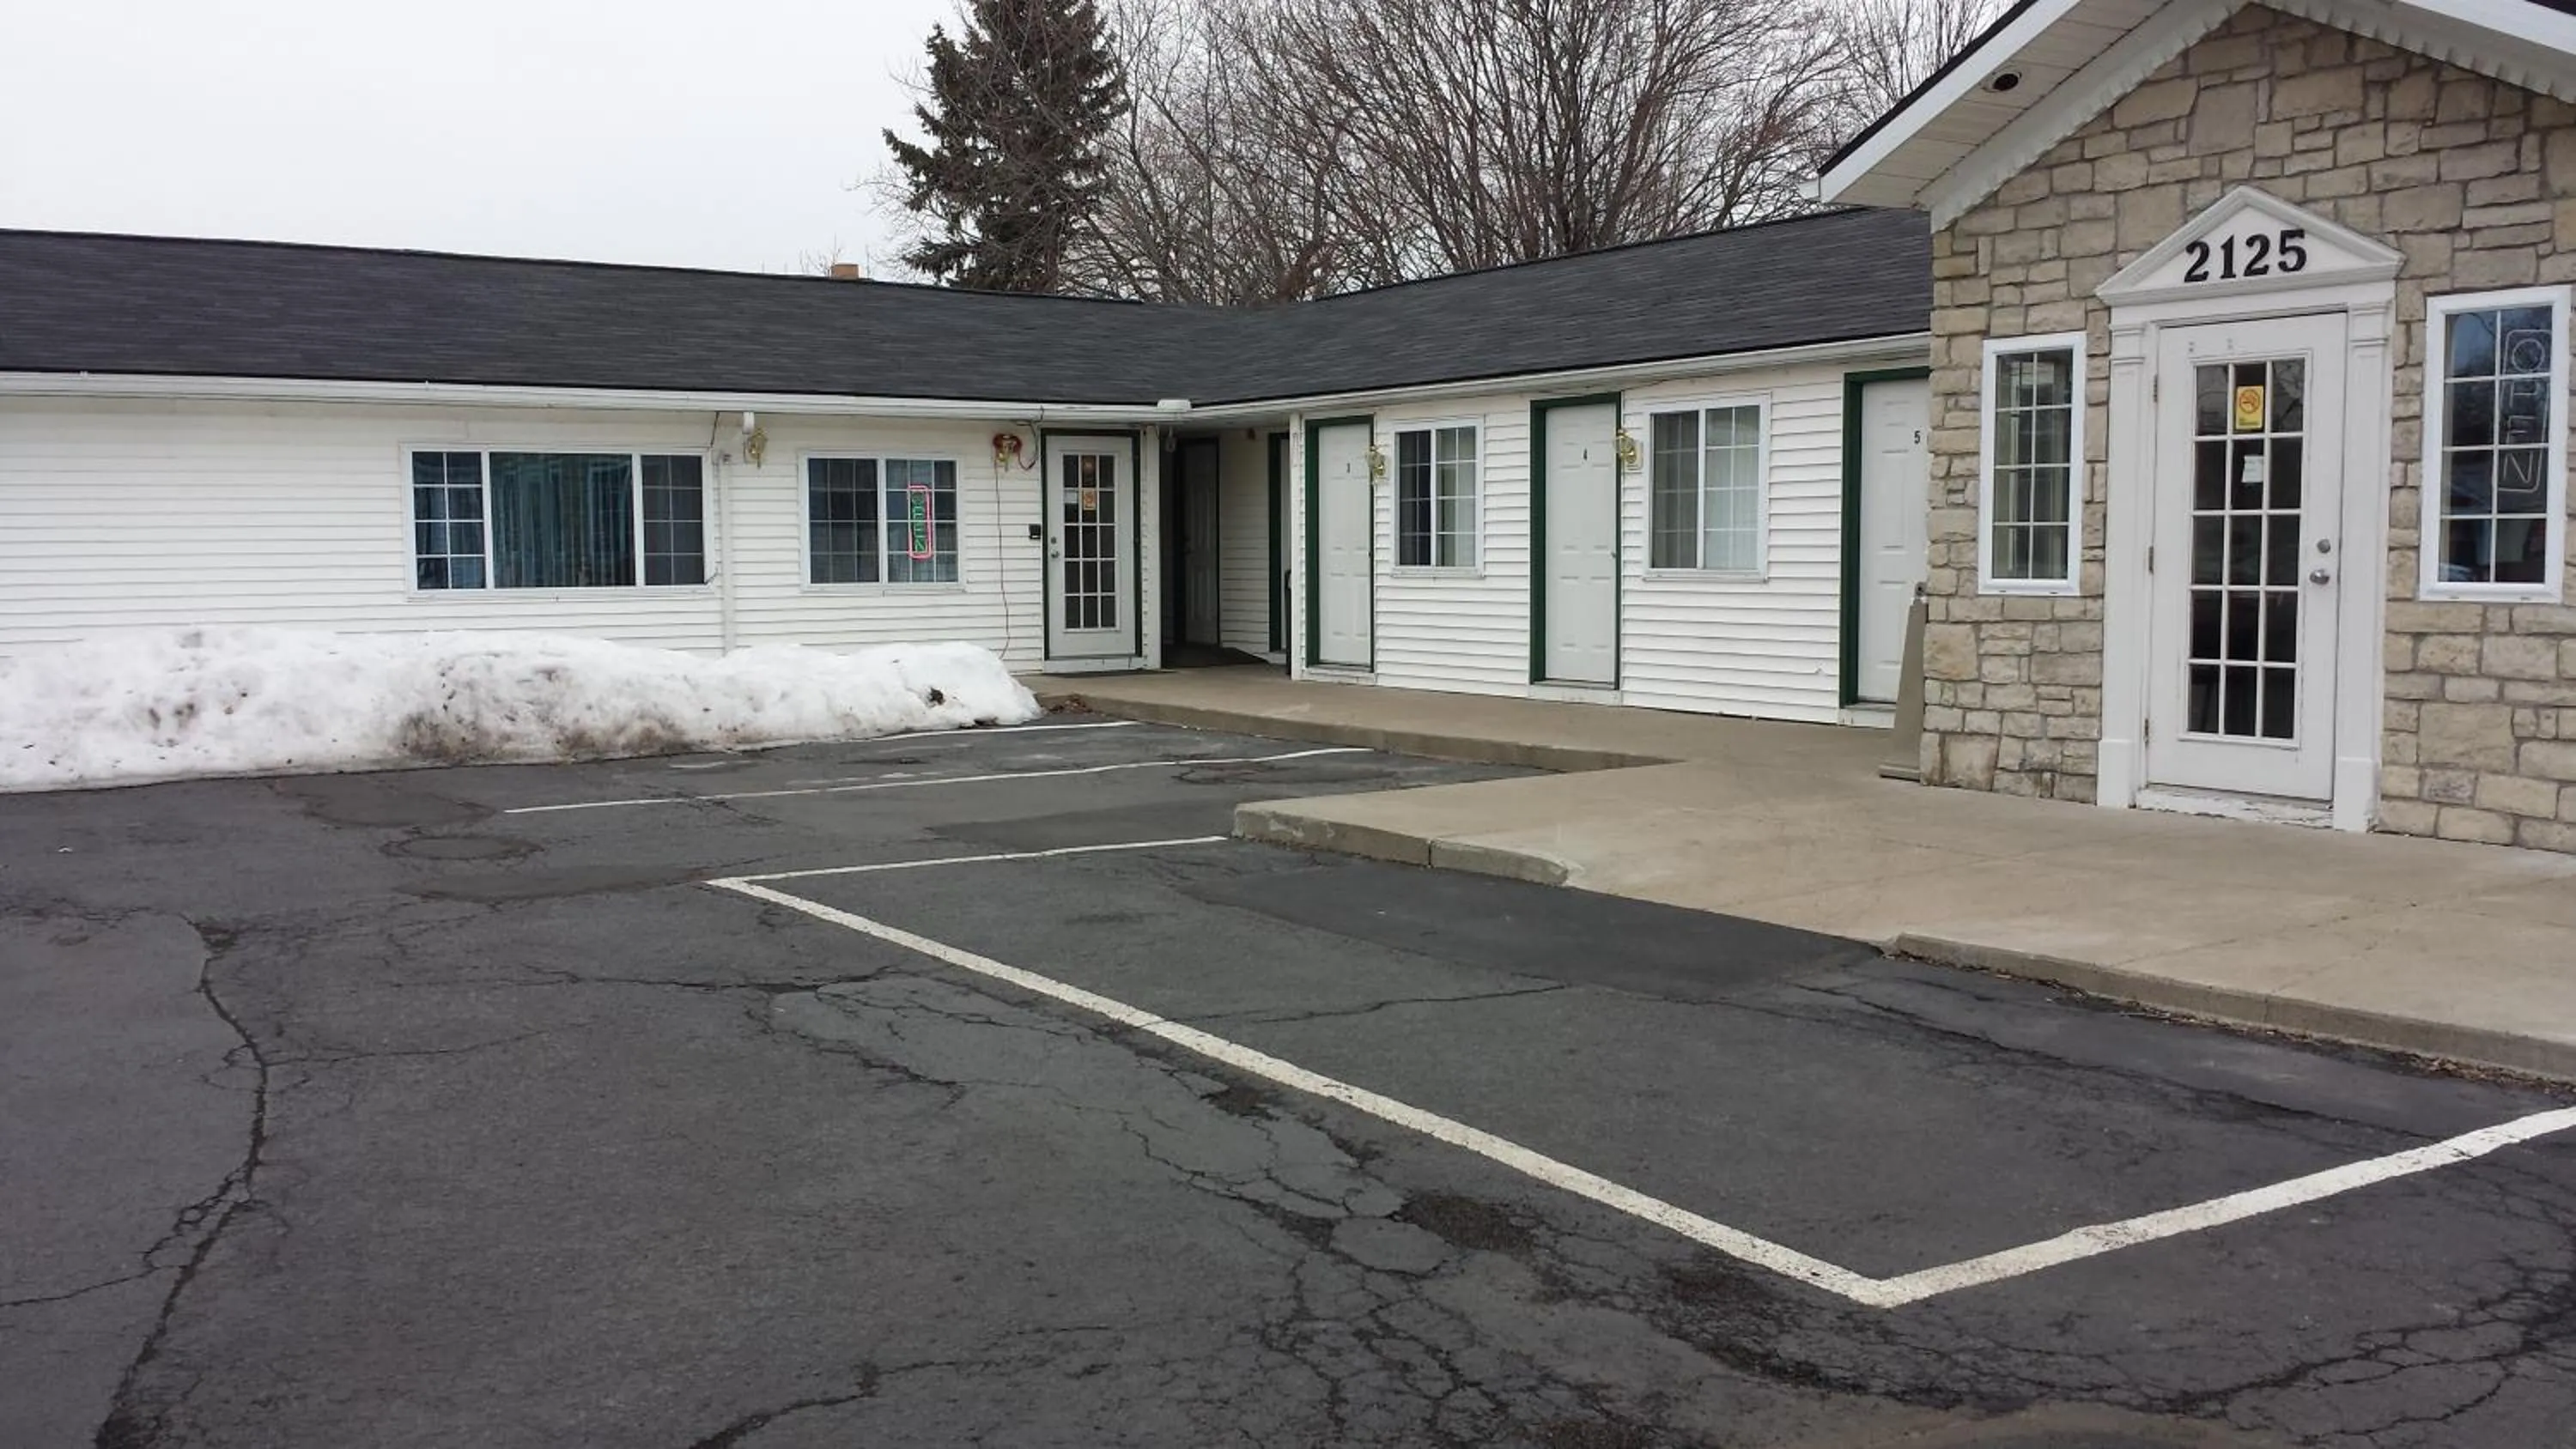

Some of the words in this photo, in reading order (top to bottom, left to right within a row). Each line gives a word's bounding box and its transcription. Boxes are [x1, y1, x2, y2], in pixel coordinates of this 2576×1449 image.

[2184, 228, 2307, 283] 2125
[1914, 430, 1921, 445] 5
[2503, 338, 2545, 483] OPEN
